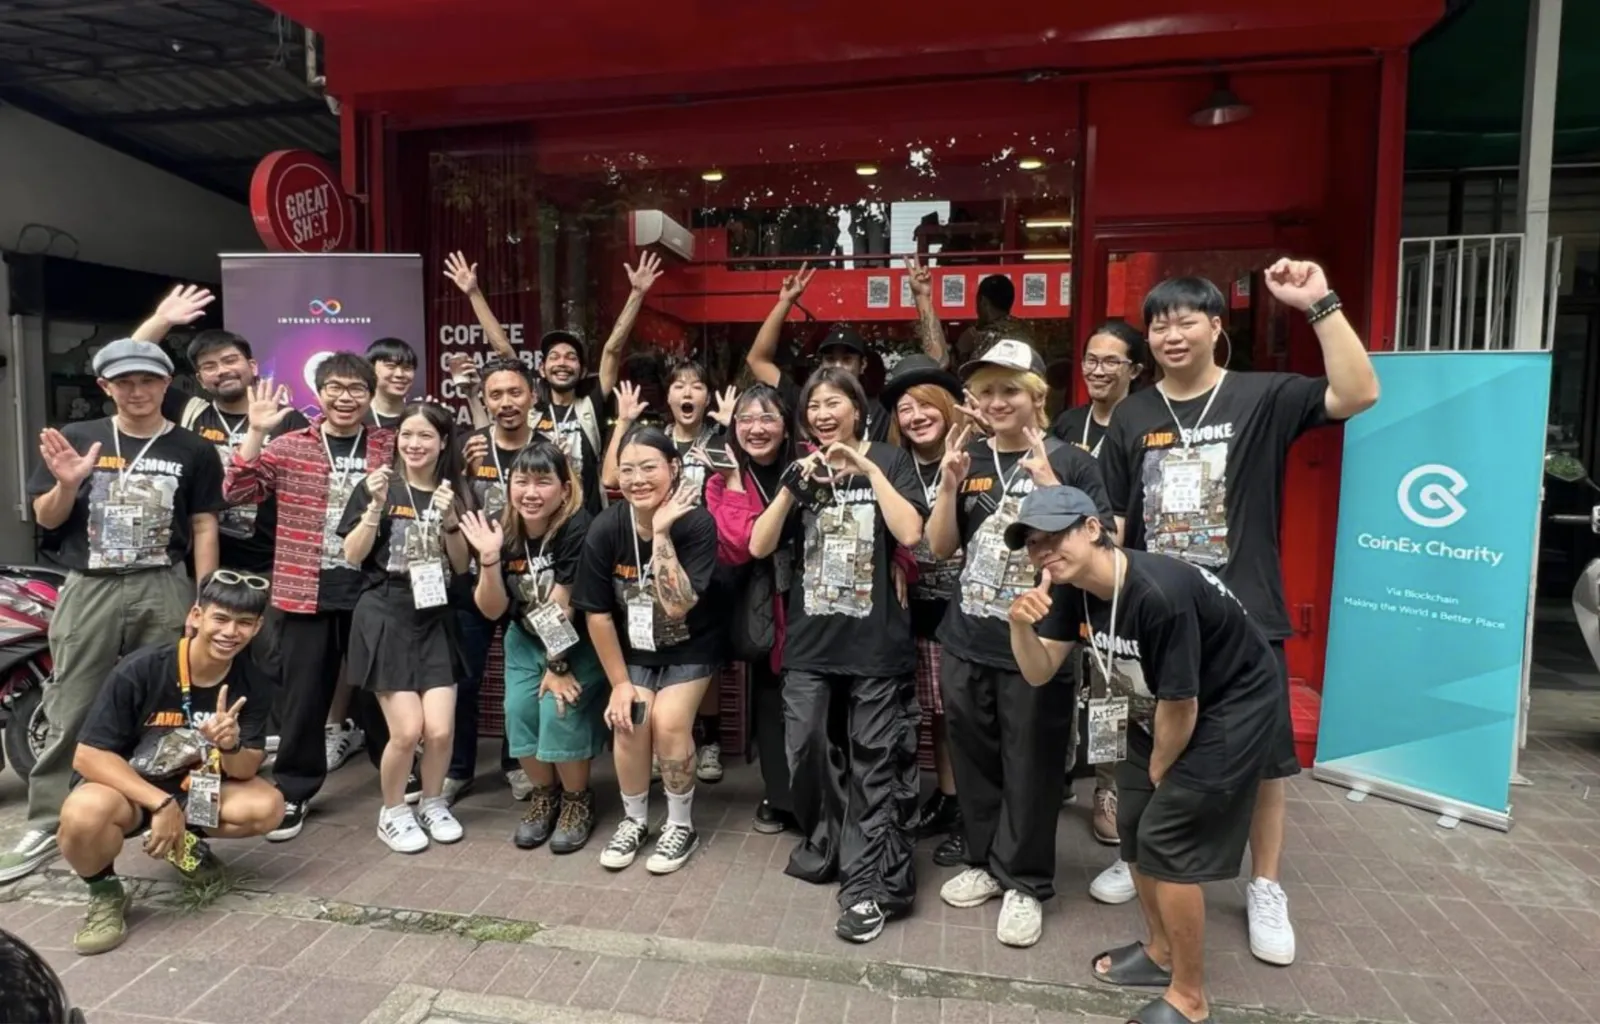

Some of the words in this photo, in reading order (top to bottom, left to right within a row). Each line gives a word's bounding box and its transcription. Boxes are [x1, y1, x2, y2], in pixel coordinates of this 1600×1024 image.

[285, 183, 329, 222] GREAT
[440, 324, 524, 345] COFE
[1183, 422, 1236, 443] SMOKE
[135, 457, 184, 477] SMOKE
[835, 487, 876, 502] SMOK
[1357, 533, 1421, 554] CoinEx
[1425, 541, 1504, 567] Charity
[1386, 586, 1402, 597] Via
[1404, 589, 1459, 605] Blockchain
[1344, 597, 1378, 611] Making
[1380, 602, 1396, 612] the
[1399, 605, 1429, 617] World
[1440, 611, 1472, 625] Better
[1475, 617, 1506, 629] Place
